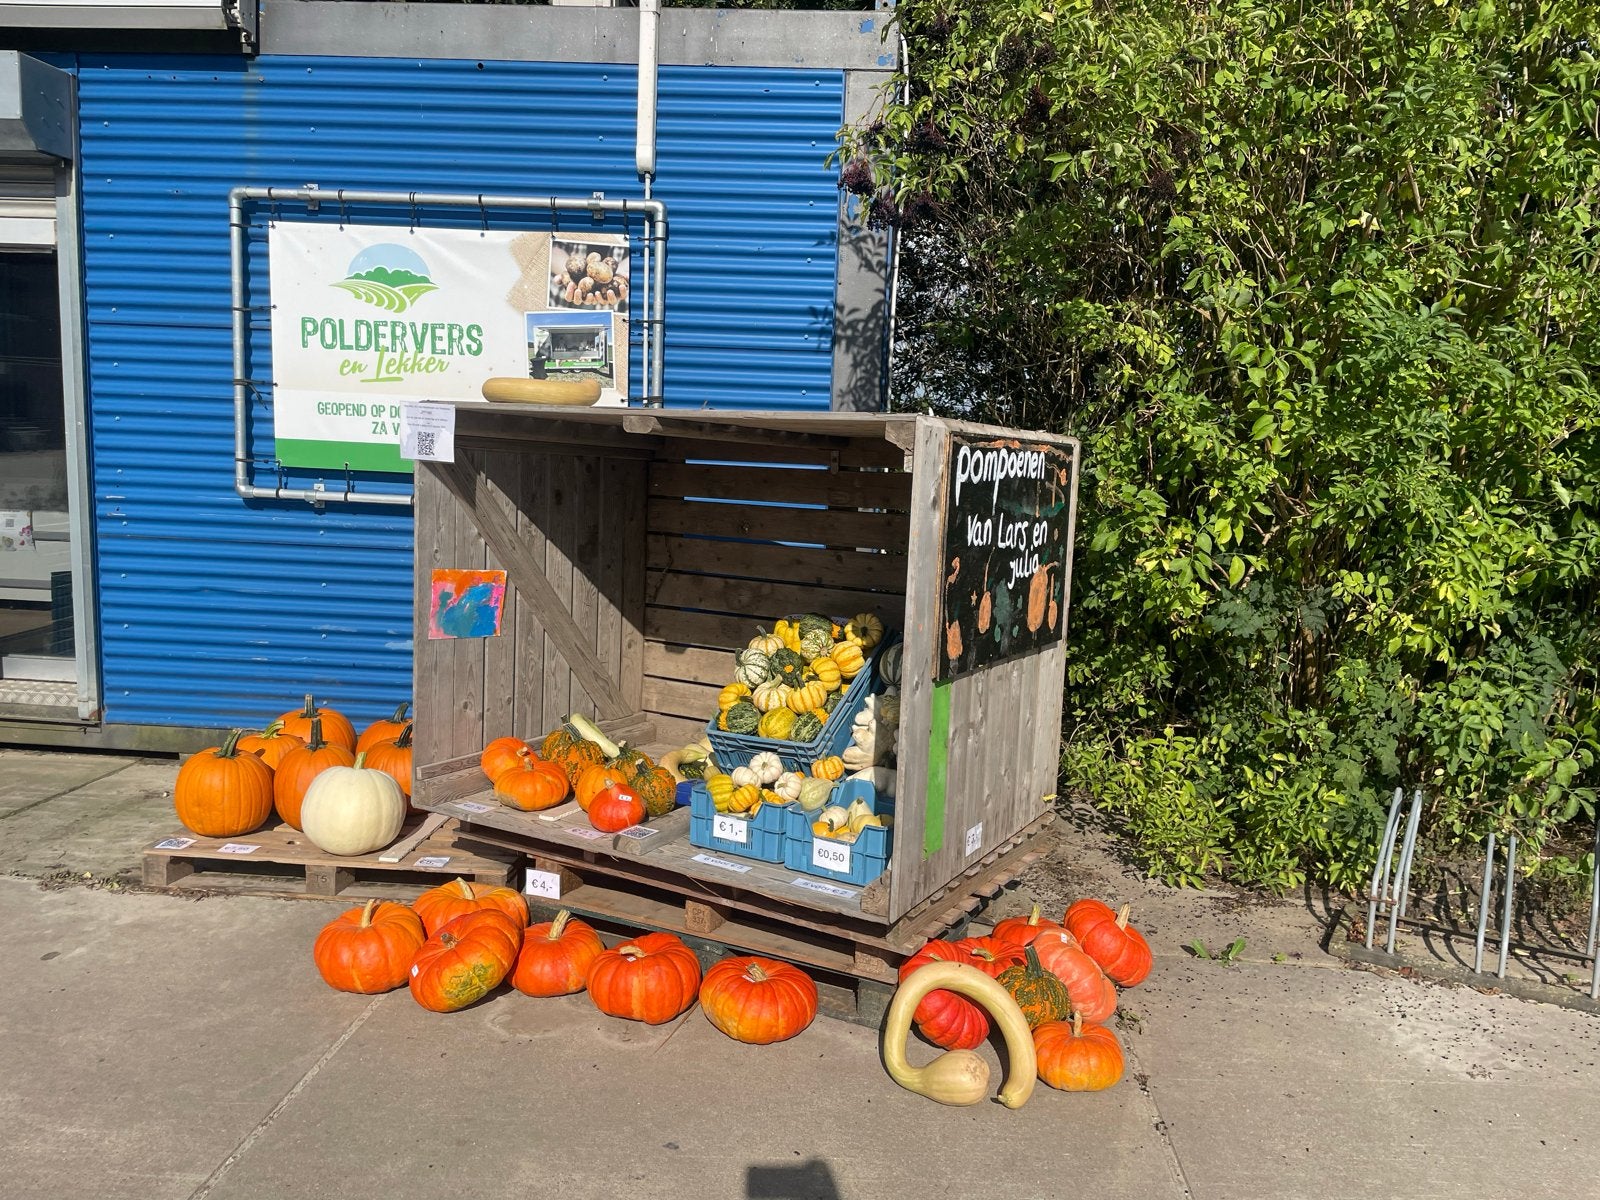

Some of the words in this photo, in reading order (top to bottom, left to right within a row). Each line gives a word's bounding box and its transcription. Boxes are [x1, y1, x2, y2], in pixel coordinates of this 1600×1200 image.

[301, 316, 484, 357] POLDERVERS
[339, 357, 368, 377] en
[360, 345, 450, 383] Lekker
[317, 401, 367, 417] GEOPEND
[371, 404, 386, 418] OP
[371, 421, 388, 435] ZA
[997, 512, 1029, 551] Lars
[1032, 520, 1048, 547] en
[817, 848, 845, 863] €0,50
